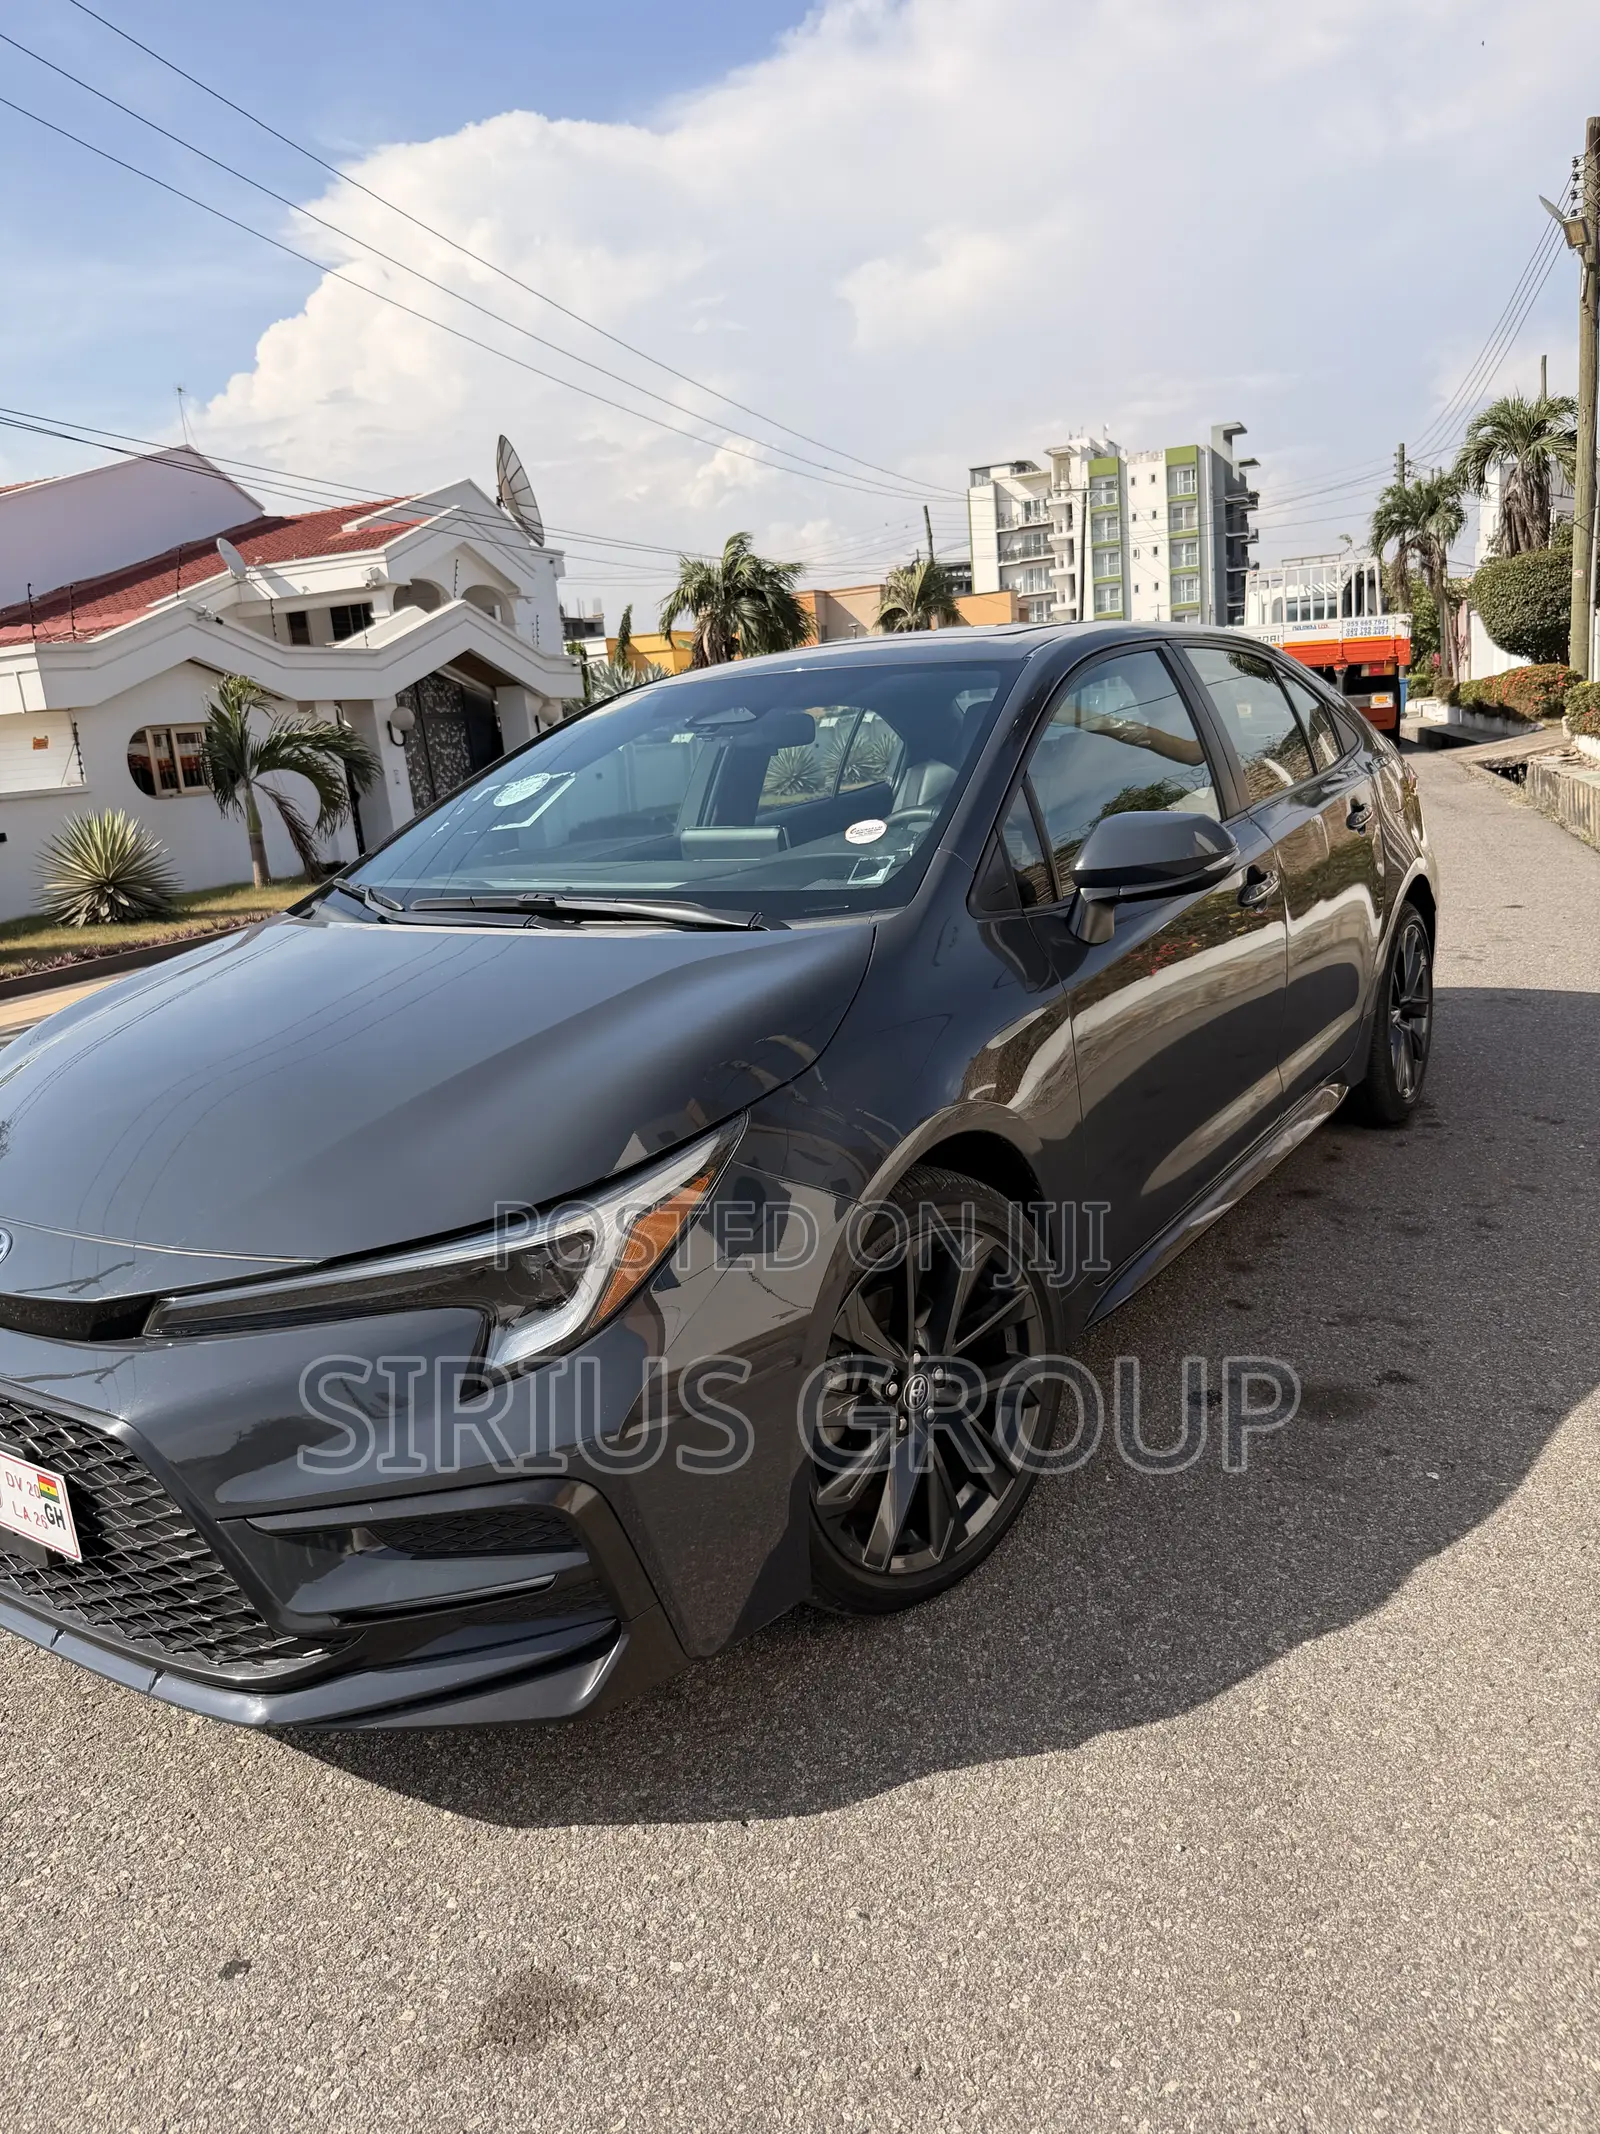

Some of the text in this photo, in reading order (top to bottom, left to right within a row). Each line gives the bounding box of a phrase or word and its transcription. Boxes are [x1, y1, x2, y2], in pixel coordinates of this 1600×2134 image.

[5, 1471, 41, 1499] DV 20
[12, 1500, 48, 1529] LA 26
[44, 1503, 66, 1530] GH
